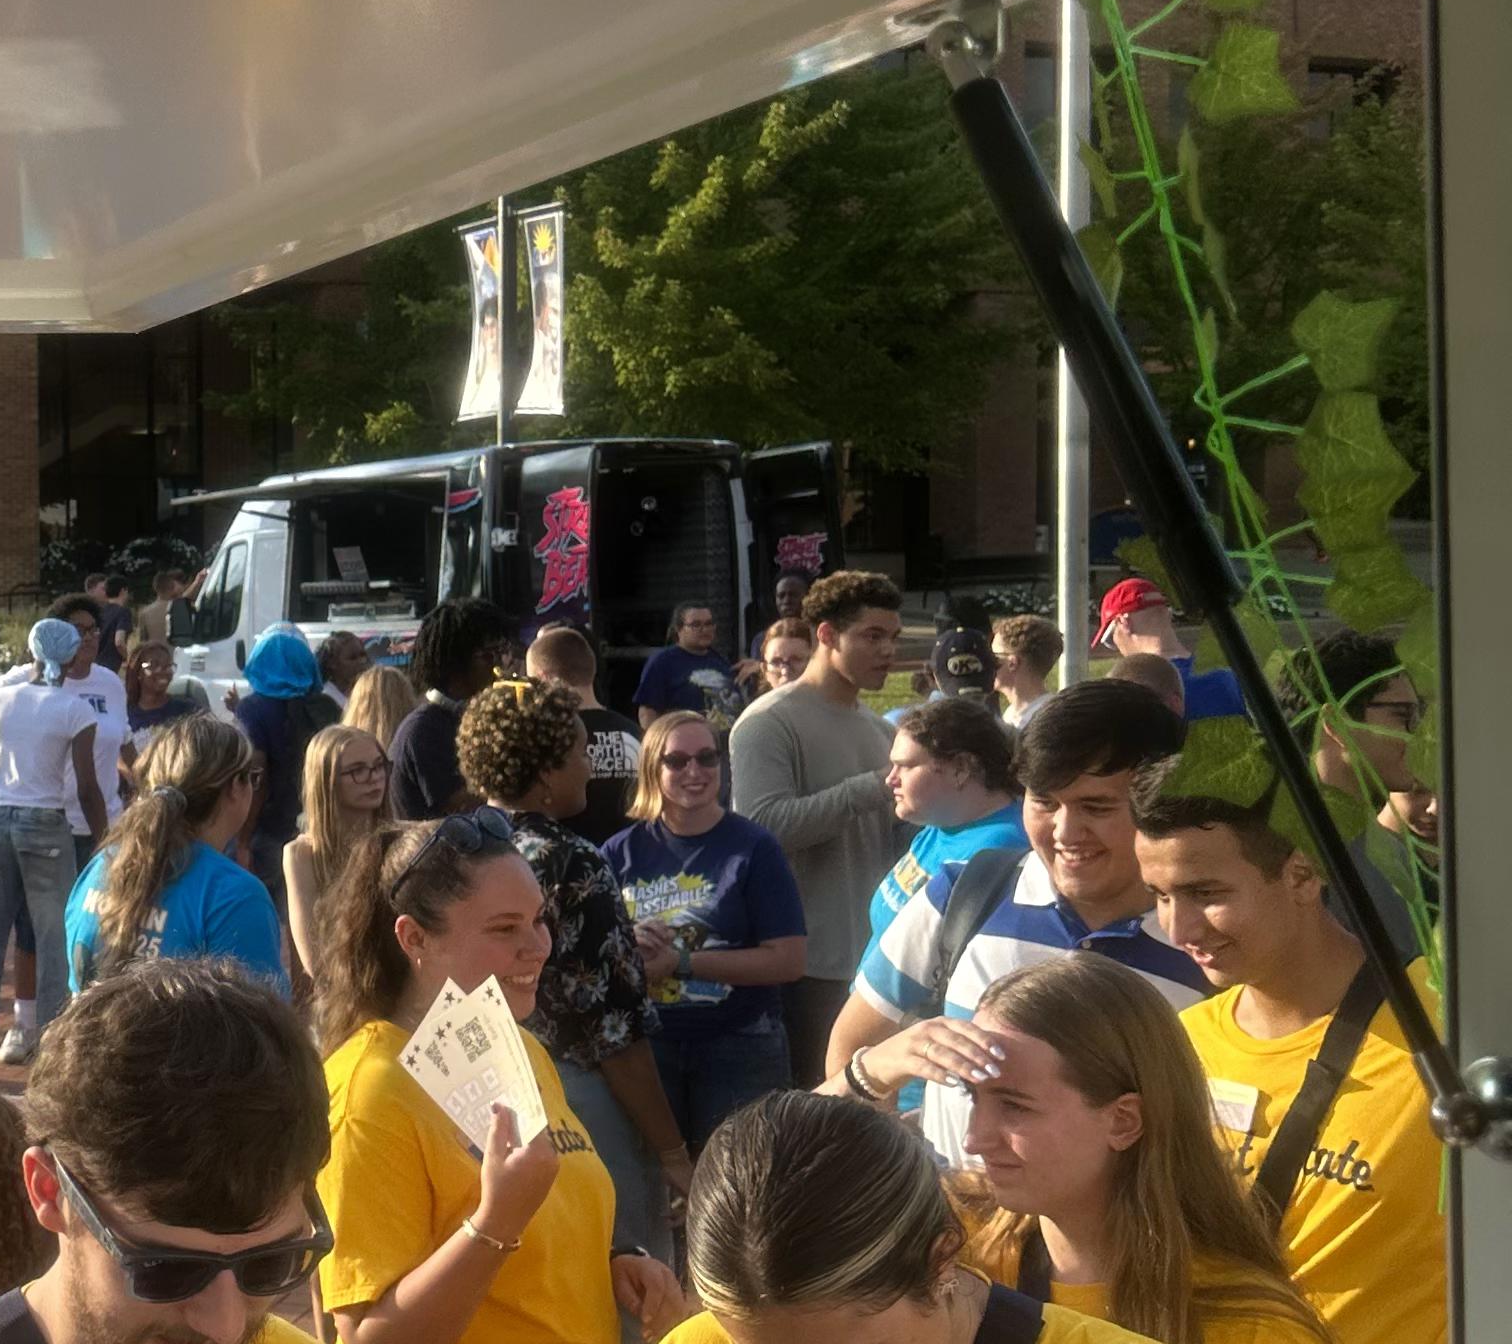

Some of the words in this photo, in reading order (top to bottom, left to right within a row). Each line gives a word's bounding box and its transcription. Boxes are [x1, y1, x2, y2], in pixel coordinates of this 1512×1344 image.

[593, 731, 621, 745] THE
[586, 743, 624, 759] ORTH
[591, 757, 624, 771] FACE
